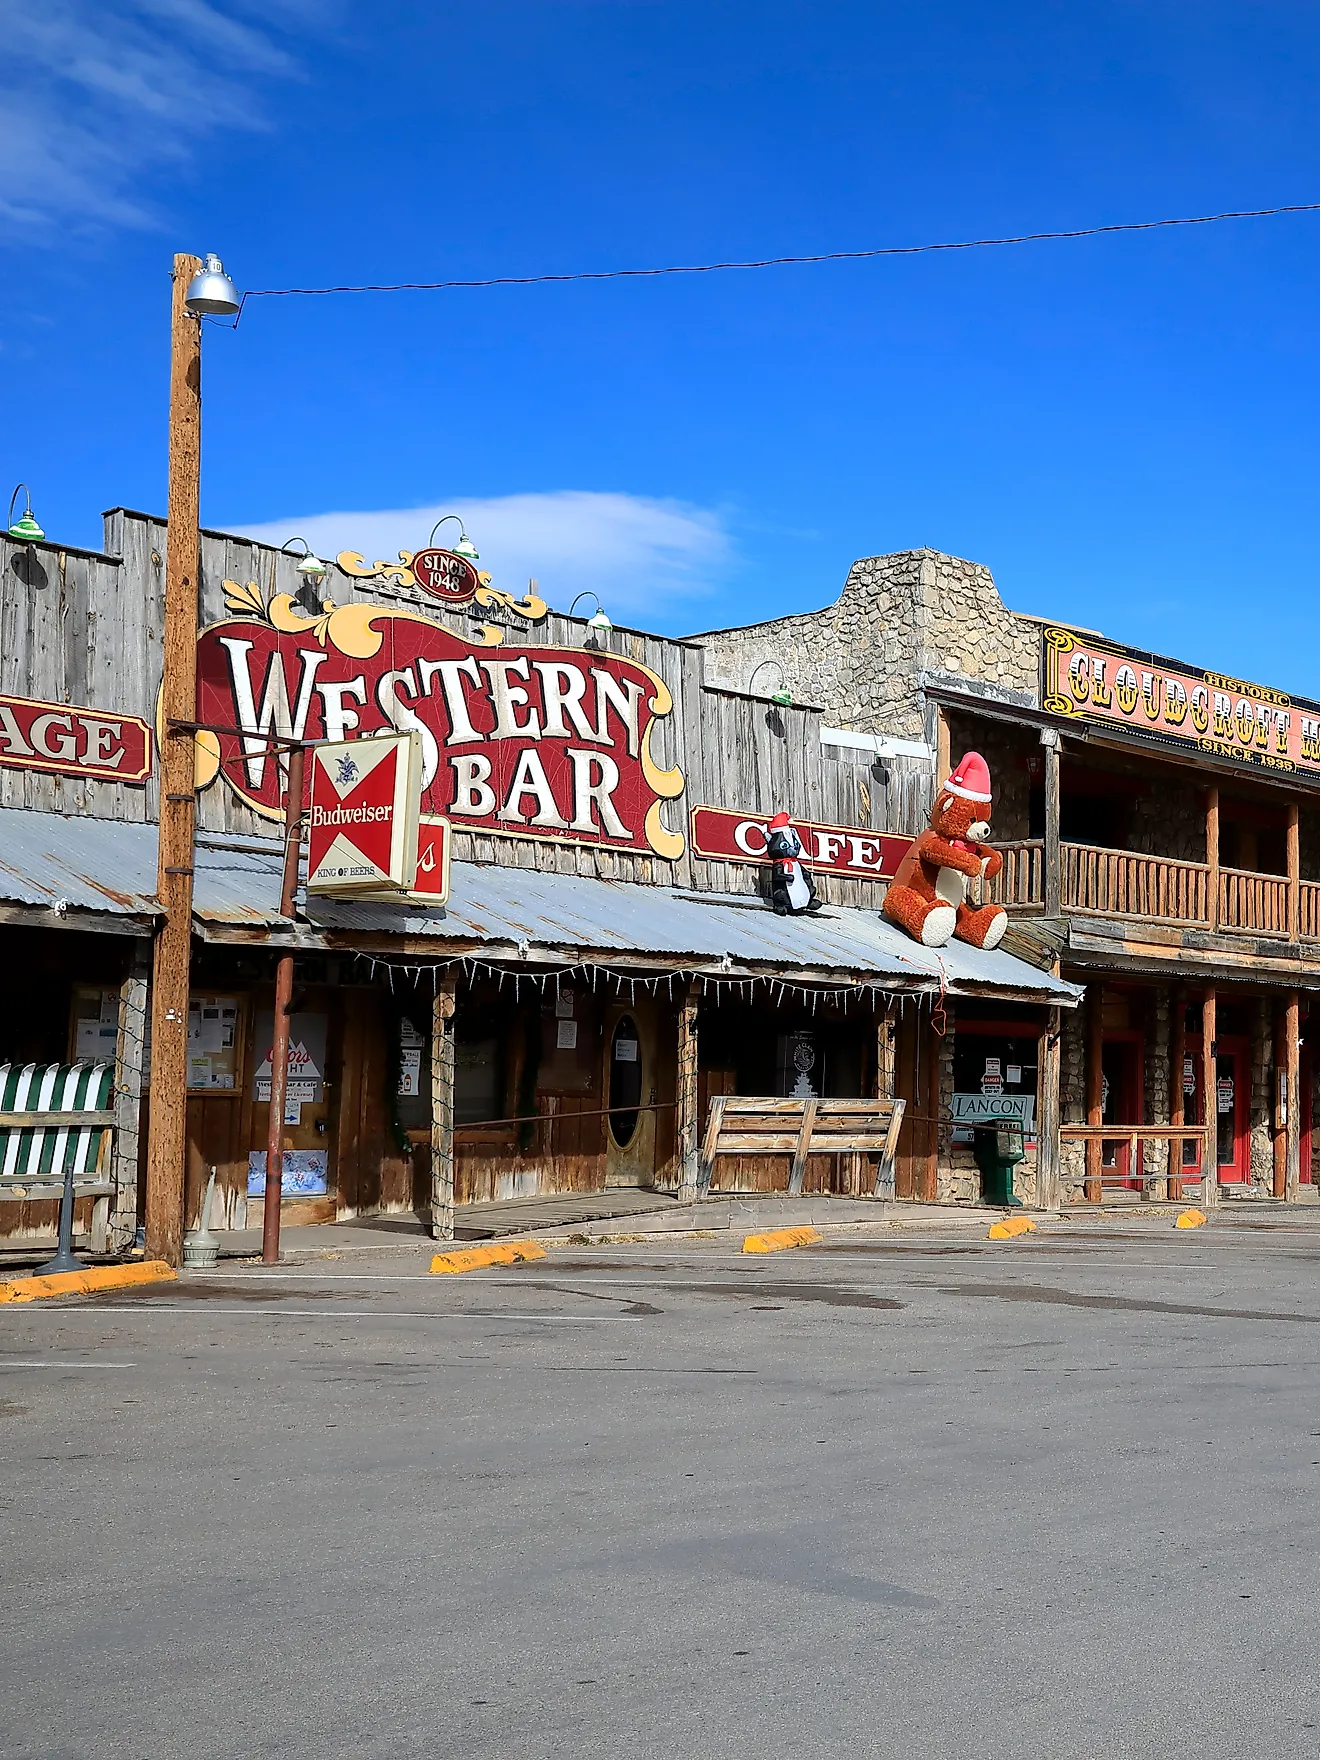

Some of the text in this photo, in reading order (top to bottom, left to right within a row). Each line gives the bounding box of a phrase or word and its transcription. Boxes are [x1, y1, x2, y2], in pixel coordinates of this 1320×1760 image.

[424, 555, 467, 578] SINCE
[428, 571, 460, 592] 1948
[1067, 651, 1291, 754] CLOUDCROFT
[1206, 673, 1289, 706] HISTORIC
[219, 636, 645, 795] WESTERN
[1201, 738, 1293, 771] SINCE 1935
[450, 747, 634, 840] BAR
[312, 801, 393, 827] Budweiser
[734, 820, 884, 872] CFE
[317, 865, 375, 878] KING OF BEERS
[265, 1046, 311, 1063] Cors
[954, 1097, 1025, 1118] LANCON
